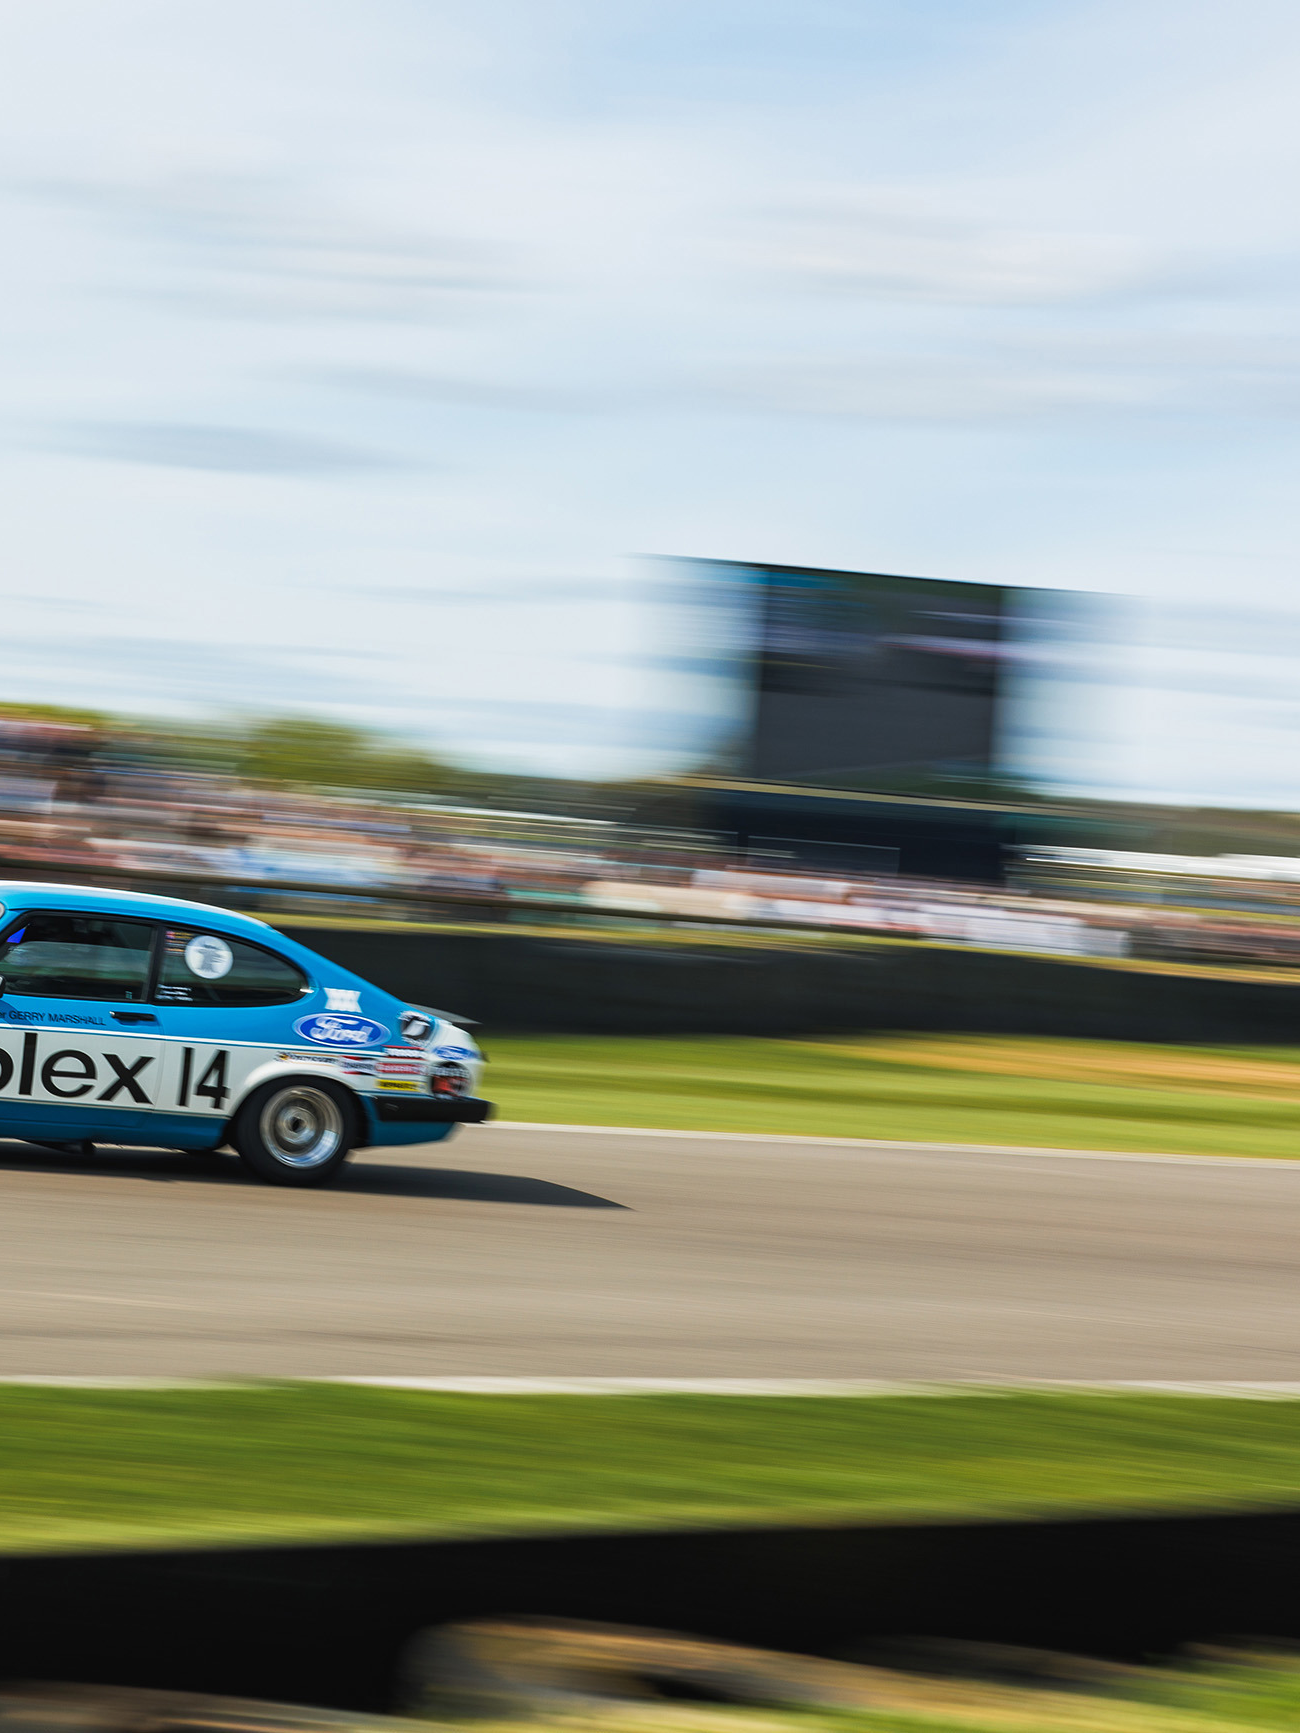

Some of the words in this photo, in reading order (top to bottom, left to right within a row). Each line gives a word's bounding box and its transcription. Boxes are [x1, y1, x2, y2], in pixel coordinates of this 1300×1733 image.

[8, 1010, 45, 1022] GERRY
[48, 1013, 106, 1026] MARSHALL
[309, 1016, 374, 1043] Ford
[177, 1046, 231, 1110] 14
